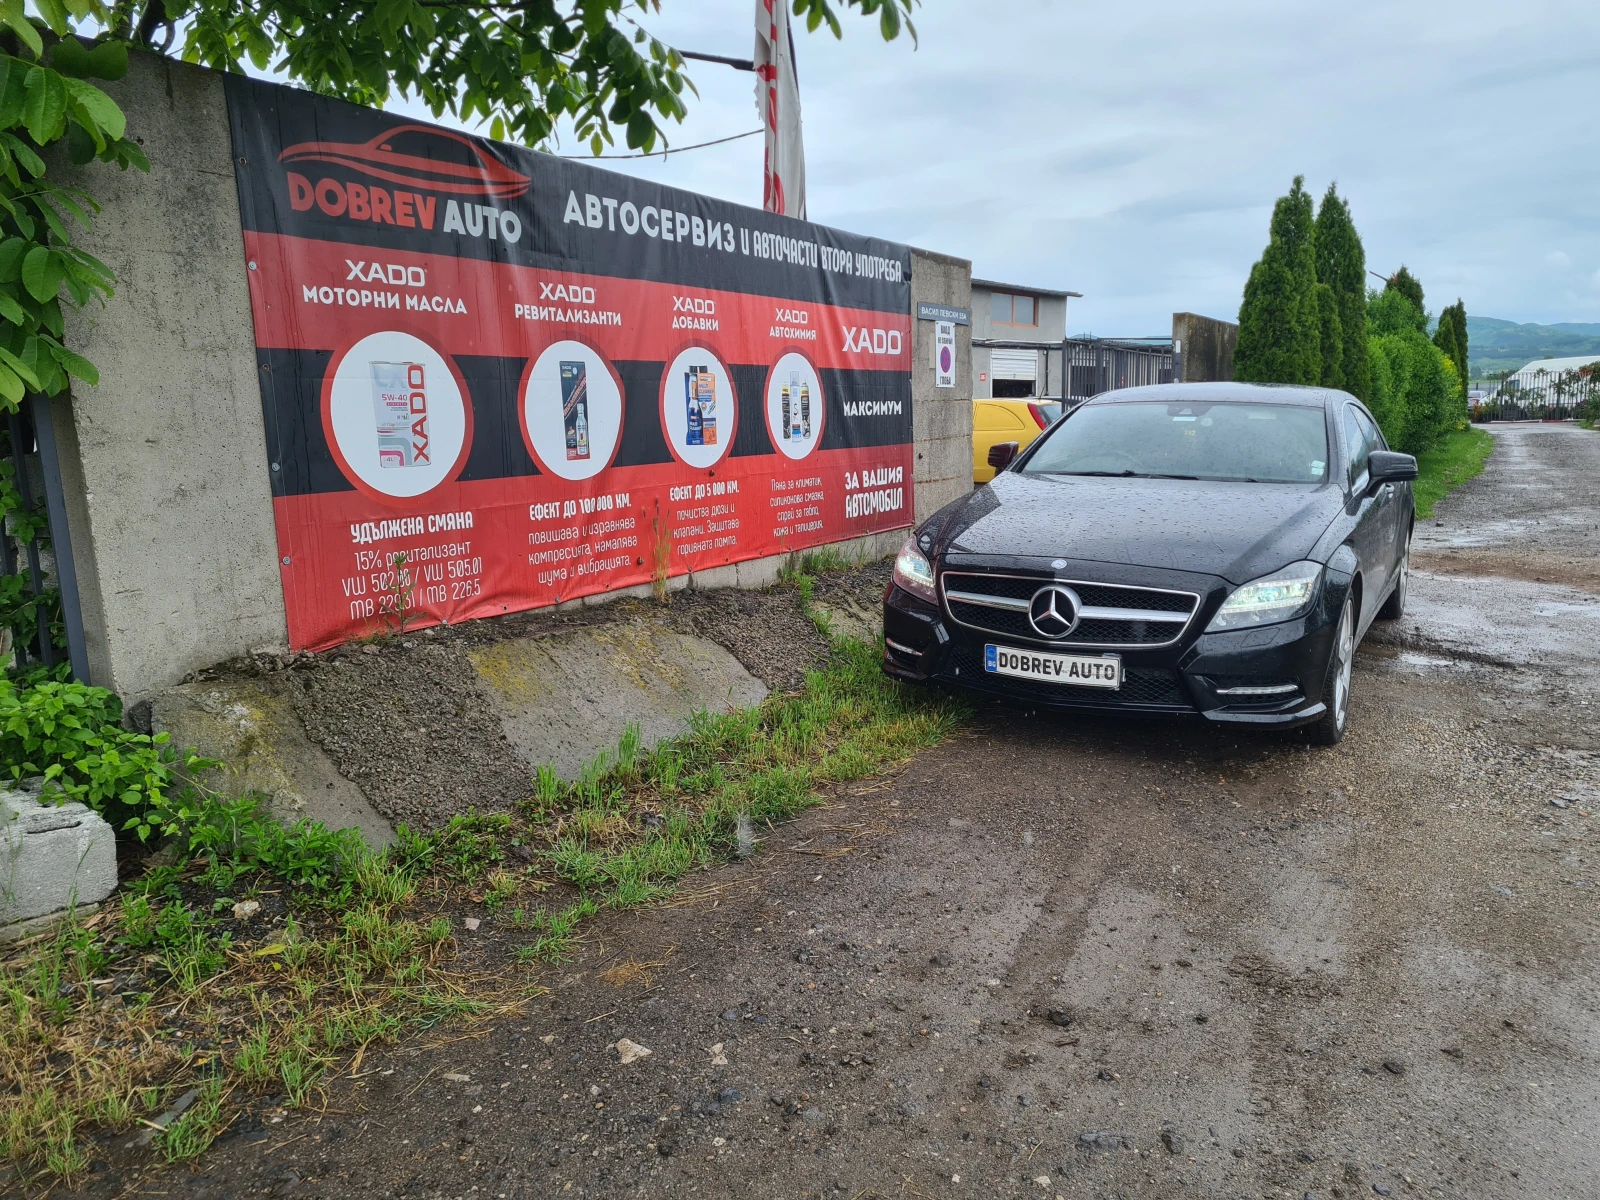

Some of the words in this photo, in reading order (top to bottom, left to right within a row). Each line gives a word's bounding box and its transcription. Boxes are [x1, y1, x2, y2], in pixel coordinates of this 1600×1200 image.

[287, 172, 436, 230] DOBREV
[443, 200, 522, 243] AUTO
[563, 190, 735, 253] АВТОСЕРВИЗ
[753, 230, 818, 268] АВТОЧАСТИ
[821, 246, 852, 275] ВТОРА
[855, 253, 902, 282] УПОТРЕБА
[345, 260, 426, 287] XADO
[302, 284, 400, 309] МОТОРНИ
[406, 294, 468, 314] МАСЛА
[540, 282, 595, 304] XADO
[514, 303, 621, 326] РЕВИТАЛИЗАНТИ
[672, 296, 715, 314] XADO
[775, 308, 808, 324] XADO
[922, 307, 939, 316] ВАСИЛ
[940, 309, 958, 319] ЛЕВСКИ
[672, 316, 719, 332] ДОБАВКИ
[770, 326, 816, 340] АВТОХИМИЯ
[842, 326, 901, 355] XADO
[382, 394, 408, 402] 5W-40
[843, 401, 902, 416] МАКСИМУМ
[408, 365, 430, 463] XADO
[771, 478, 786, 492] Пяна
[844, 472, 860, 490] ЗА
[862, 466, 903, 488] ВАШИЯ
[670, 485, 692, 502] ЕФЕКТ
[695, 483, 705, 500] ДО
[707, 483, 712, 497] 5
[712, 482, 726, 496] 000
[727, 480, 740, 493] КМ.
[530, 502, 560, 521] ЕФЕКТ
[563, 500, 576, 519] ДО
[615, 492, 632, 509] КМ.
[677, 506, 710, 520] почиства
[711, 504, 729, 517] дюзи
[845, 487, 903, 519] АВТОМОБИЛ
[350, 516, 424, 545] УДЪЛЖЕНА
[428, 511, 473, 533] СМЯНА
[528, 526, 579, 545] повишава
[588, 517, 636, 536] изравнява
[674, 524, 705, 539] клапани.
[707, 518, 740, 534] Защитава
[528, 544, 592, 565] компресията,
[594, 535, 638, 552] намалява
[677, 539, 712, 556] горивната
[714, 534, 738, 548] помпа.
[354, 549, 382, 570] 15%
[538, 567, 567, 587] шума
[577, 555, 632, 576] вибрацията.
[342, 576, 366, 597] VW
[424, 562, 444, 583] VW
[448, 557, 483, 578] 505.01
[452, 579, 481, 600] 226.5
[999, 652, 1063, 676] DOBREV
[1069, 662, 1115, 680] AUTO
